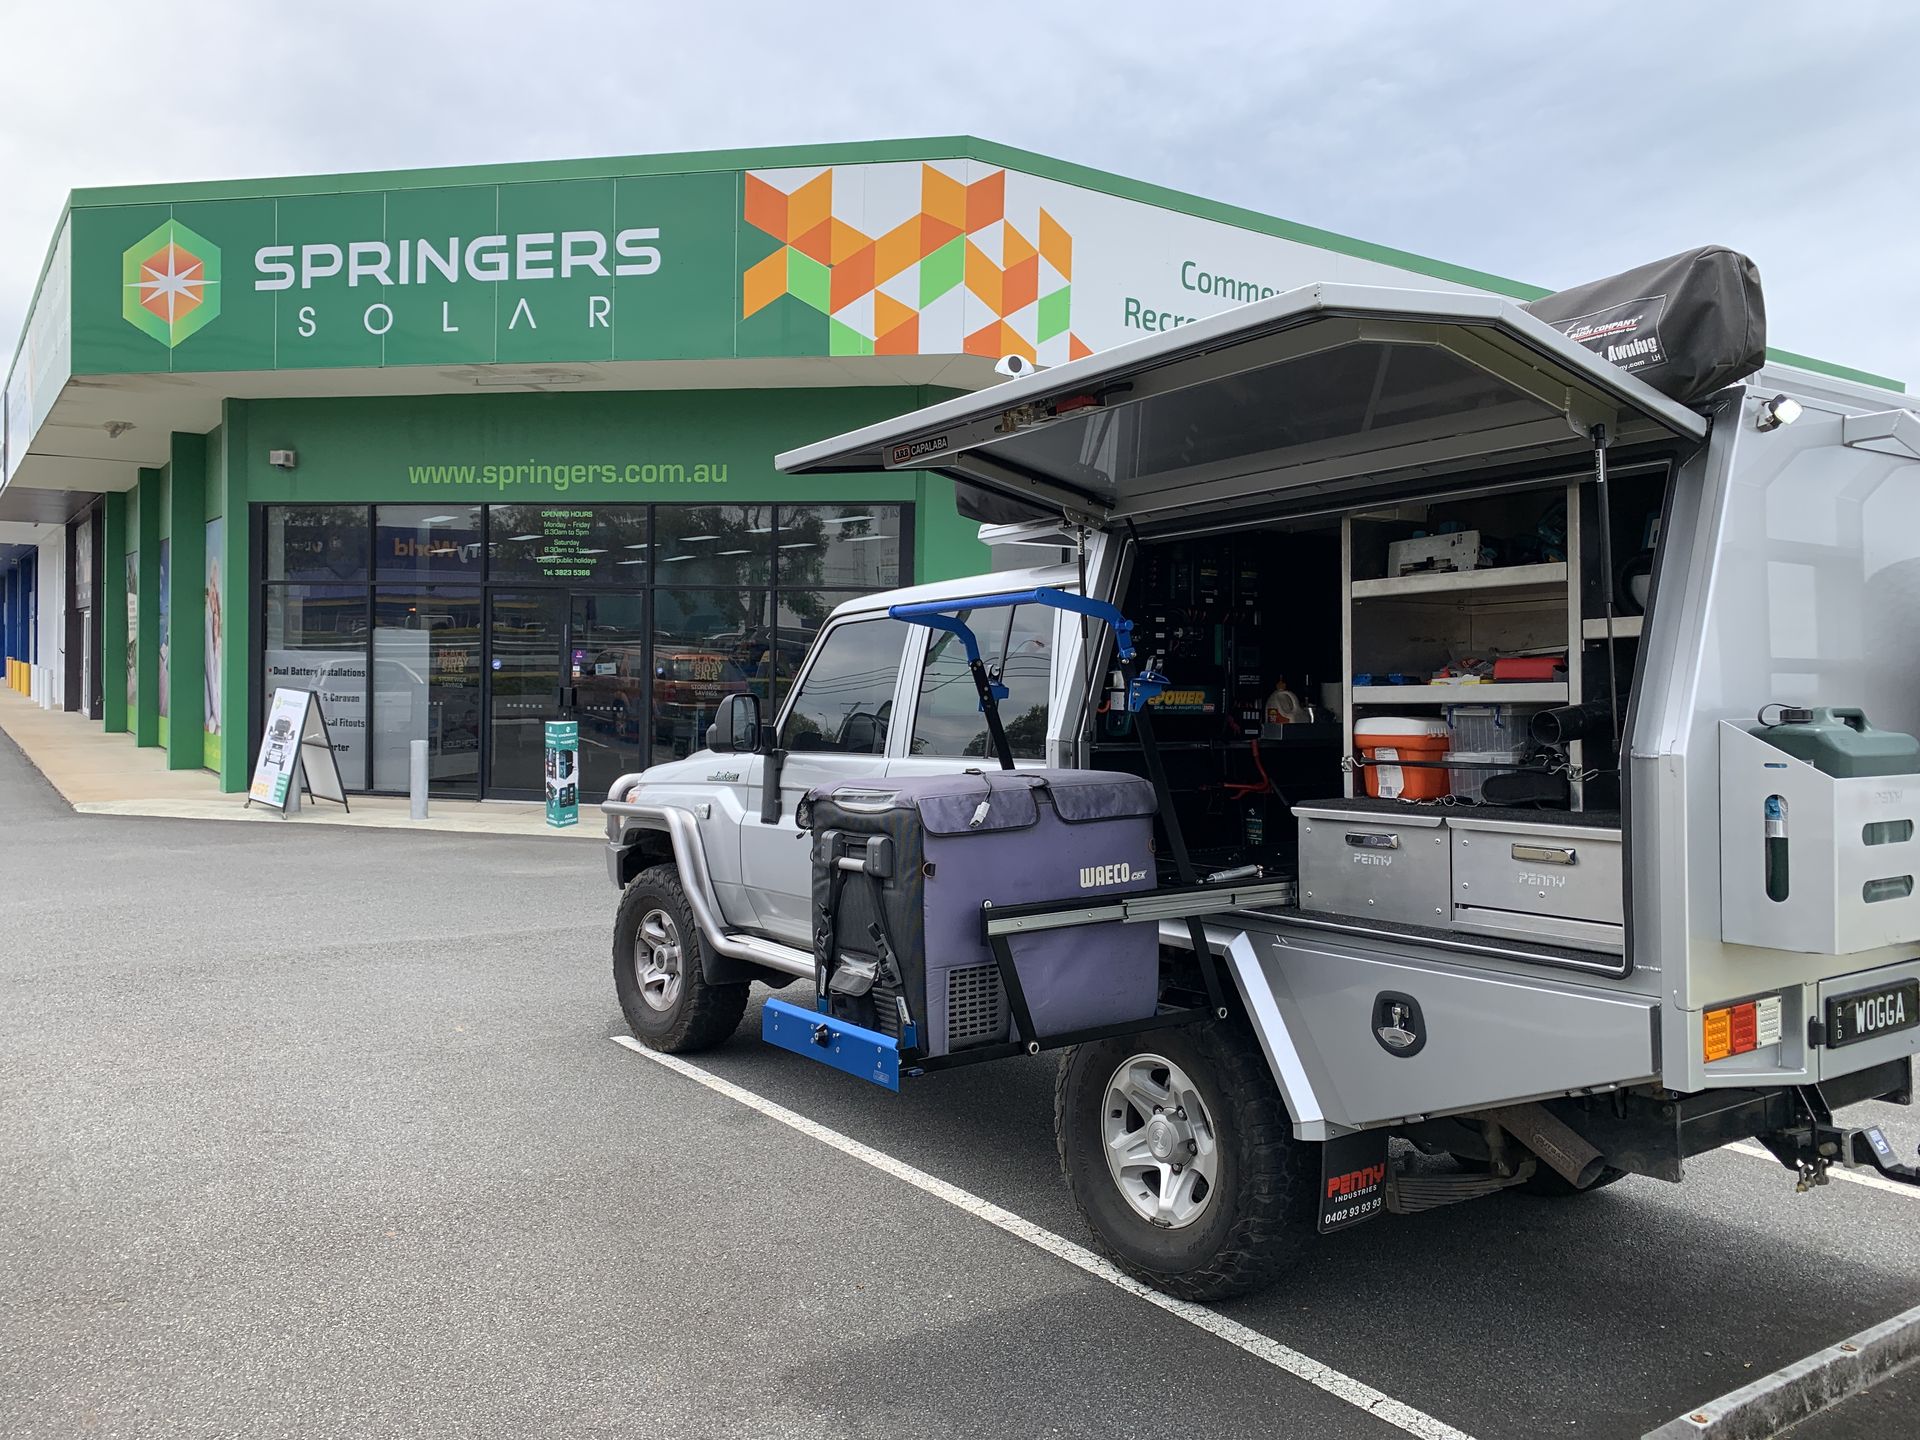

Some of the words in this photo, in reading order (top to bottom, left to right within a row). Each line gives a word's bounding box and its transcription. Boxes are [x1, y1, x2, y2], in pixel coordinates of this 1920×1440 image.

[254, 228, 662, 291] SPRINGERS
[298, 296, 611, 337] SOLAR
[1593, 317, 1638, 333] COMPANY
[1608, 336, 1658, 362] Awning
[1651, 353, 1661, 362] LH
[911, 437, 948, 456] CAPALABA
[408, 458, 728, 491] www.springers.com.au
[543, 521, 566, 529] Monday
[572, 521, 591, 529] Friday
[575, 528, 589, 536] 5pm
[573, 557, 597, 565] holidays
[437, 656, 469, 666] FRIDAY
[689, 663, 723, 673] FRIDAY
[273, 666, 289, 675] Dual
[290, 666, 318, 678] Battery
[441, 665, 464, 673] SALE
[694, 672, 718, 680] SALE
[330, 693, 360, 703] Caravan
[339, 718, 366, 728] Fitouts
[1353, 852, 1392, 866] PENNY
[1079, 863, 1130, 888] WAECO
[1131, 870, 1148, 881] CFX
[1518, 871, 1566, 888] PENNY
[1855, 992, 1906, 1034] WOGGA
[1327, 1162, 1385, 1199] PENNY
[1334, 1184, 1378, 1203] INDUSTRIES
[1325, 1209, 1348, 1224] 0402
[1349, 1205, 1360, 1217] 93
[1361, 1201, 1371, 1213] 93
[1372, 1197, 1382, 1209] 93
